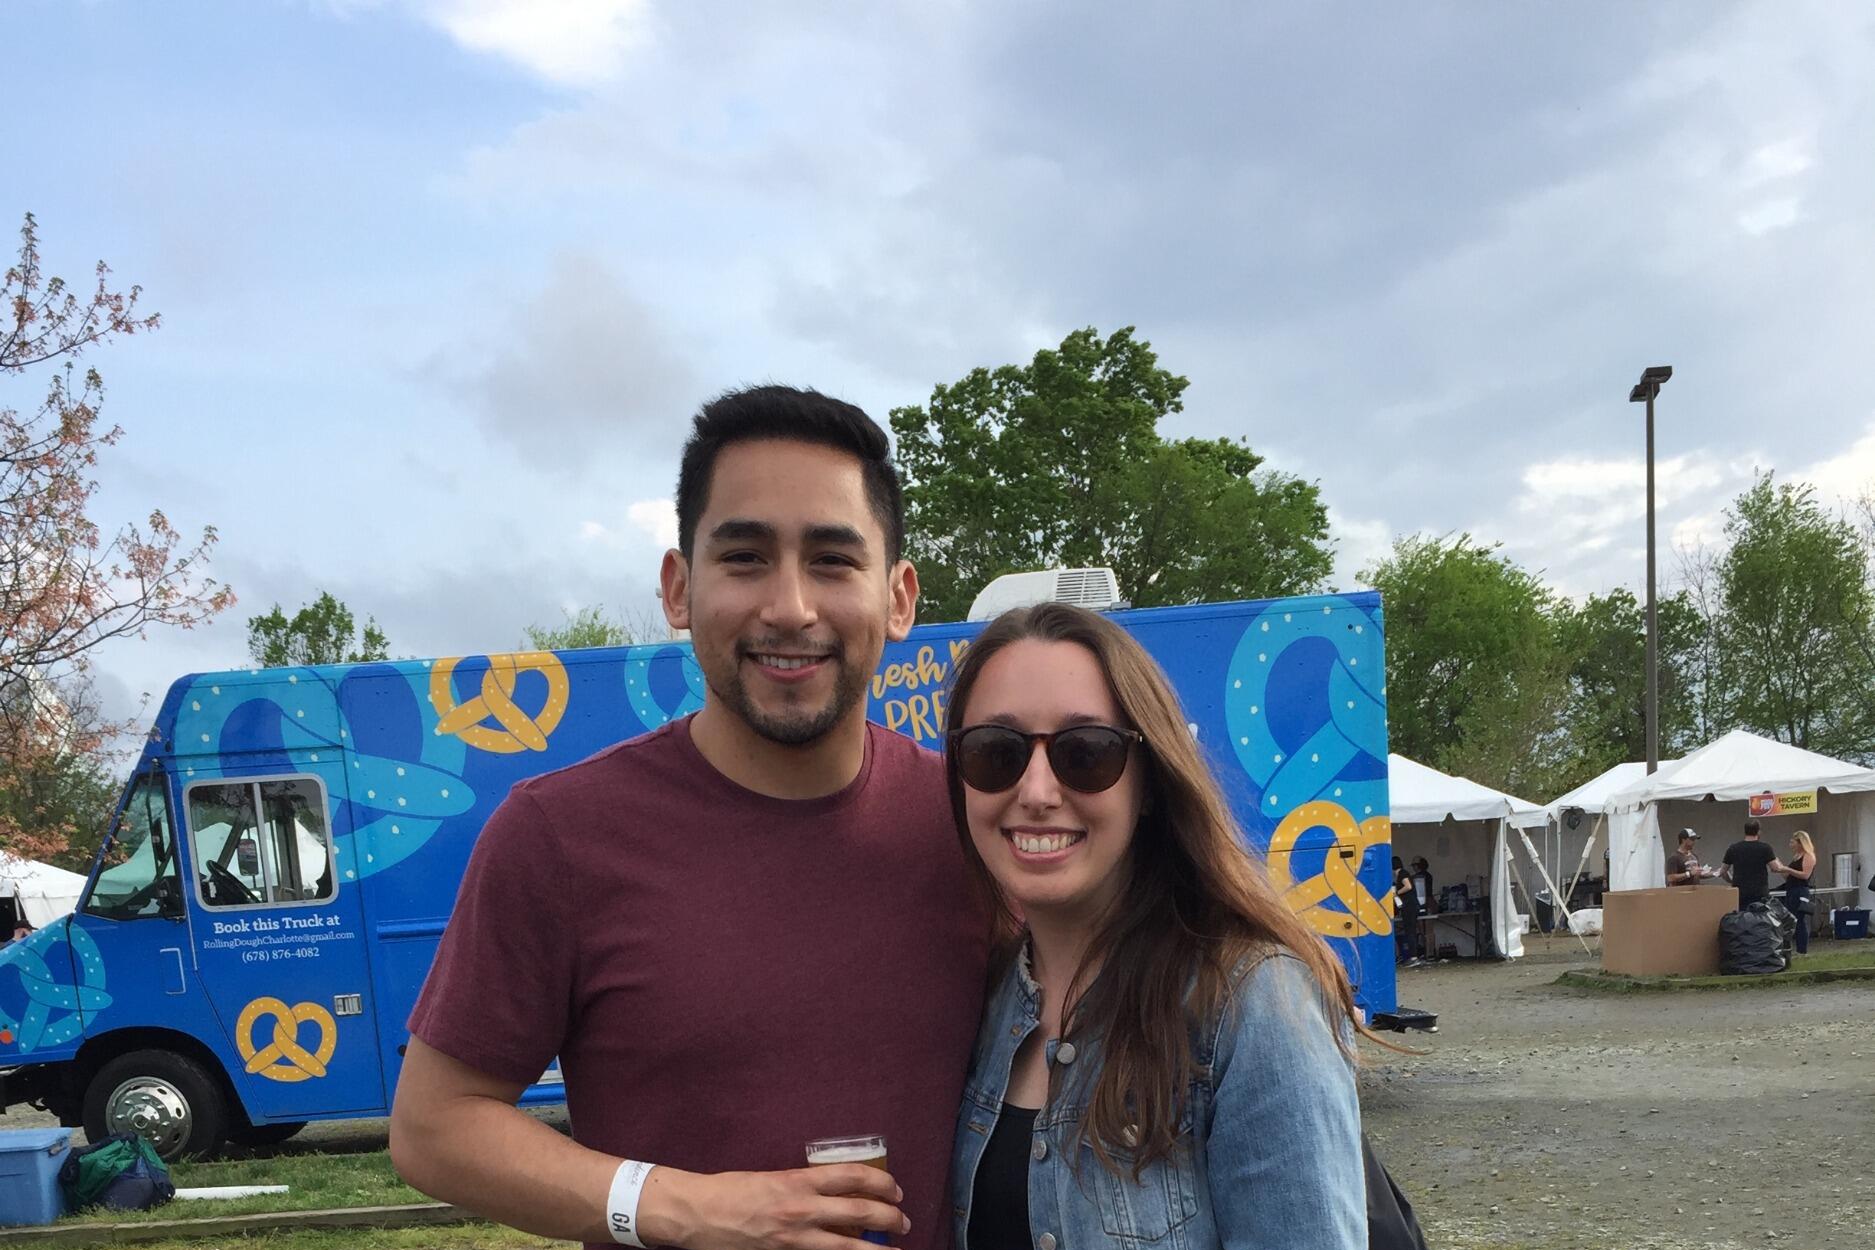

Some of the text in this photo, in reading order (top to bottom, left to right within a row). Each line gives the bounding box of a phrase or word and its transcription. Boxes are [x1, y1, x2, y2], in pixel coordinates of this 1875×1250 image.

[872, 645, 948, 699] resh
[1778, 795, 1812, 804] HICKORY
[1780, 802, 1810, 810] TAVERN
[213, 914, 341, 934] Book this Truck at
[203, 931, 355, 949] RollingDoughCharlotte@gmail.com
[242, 947, 320, 963] (678) 876-4082
[612, 1212, 631, 1233] GA
